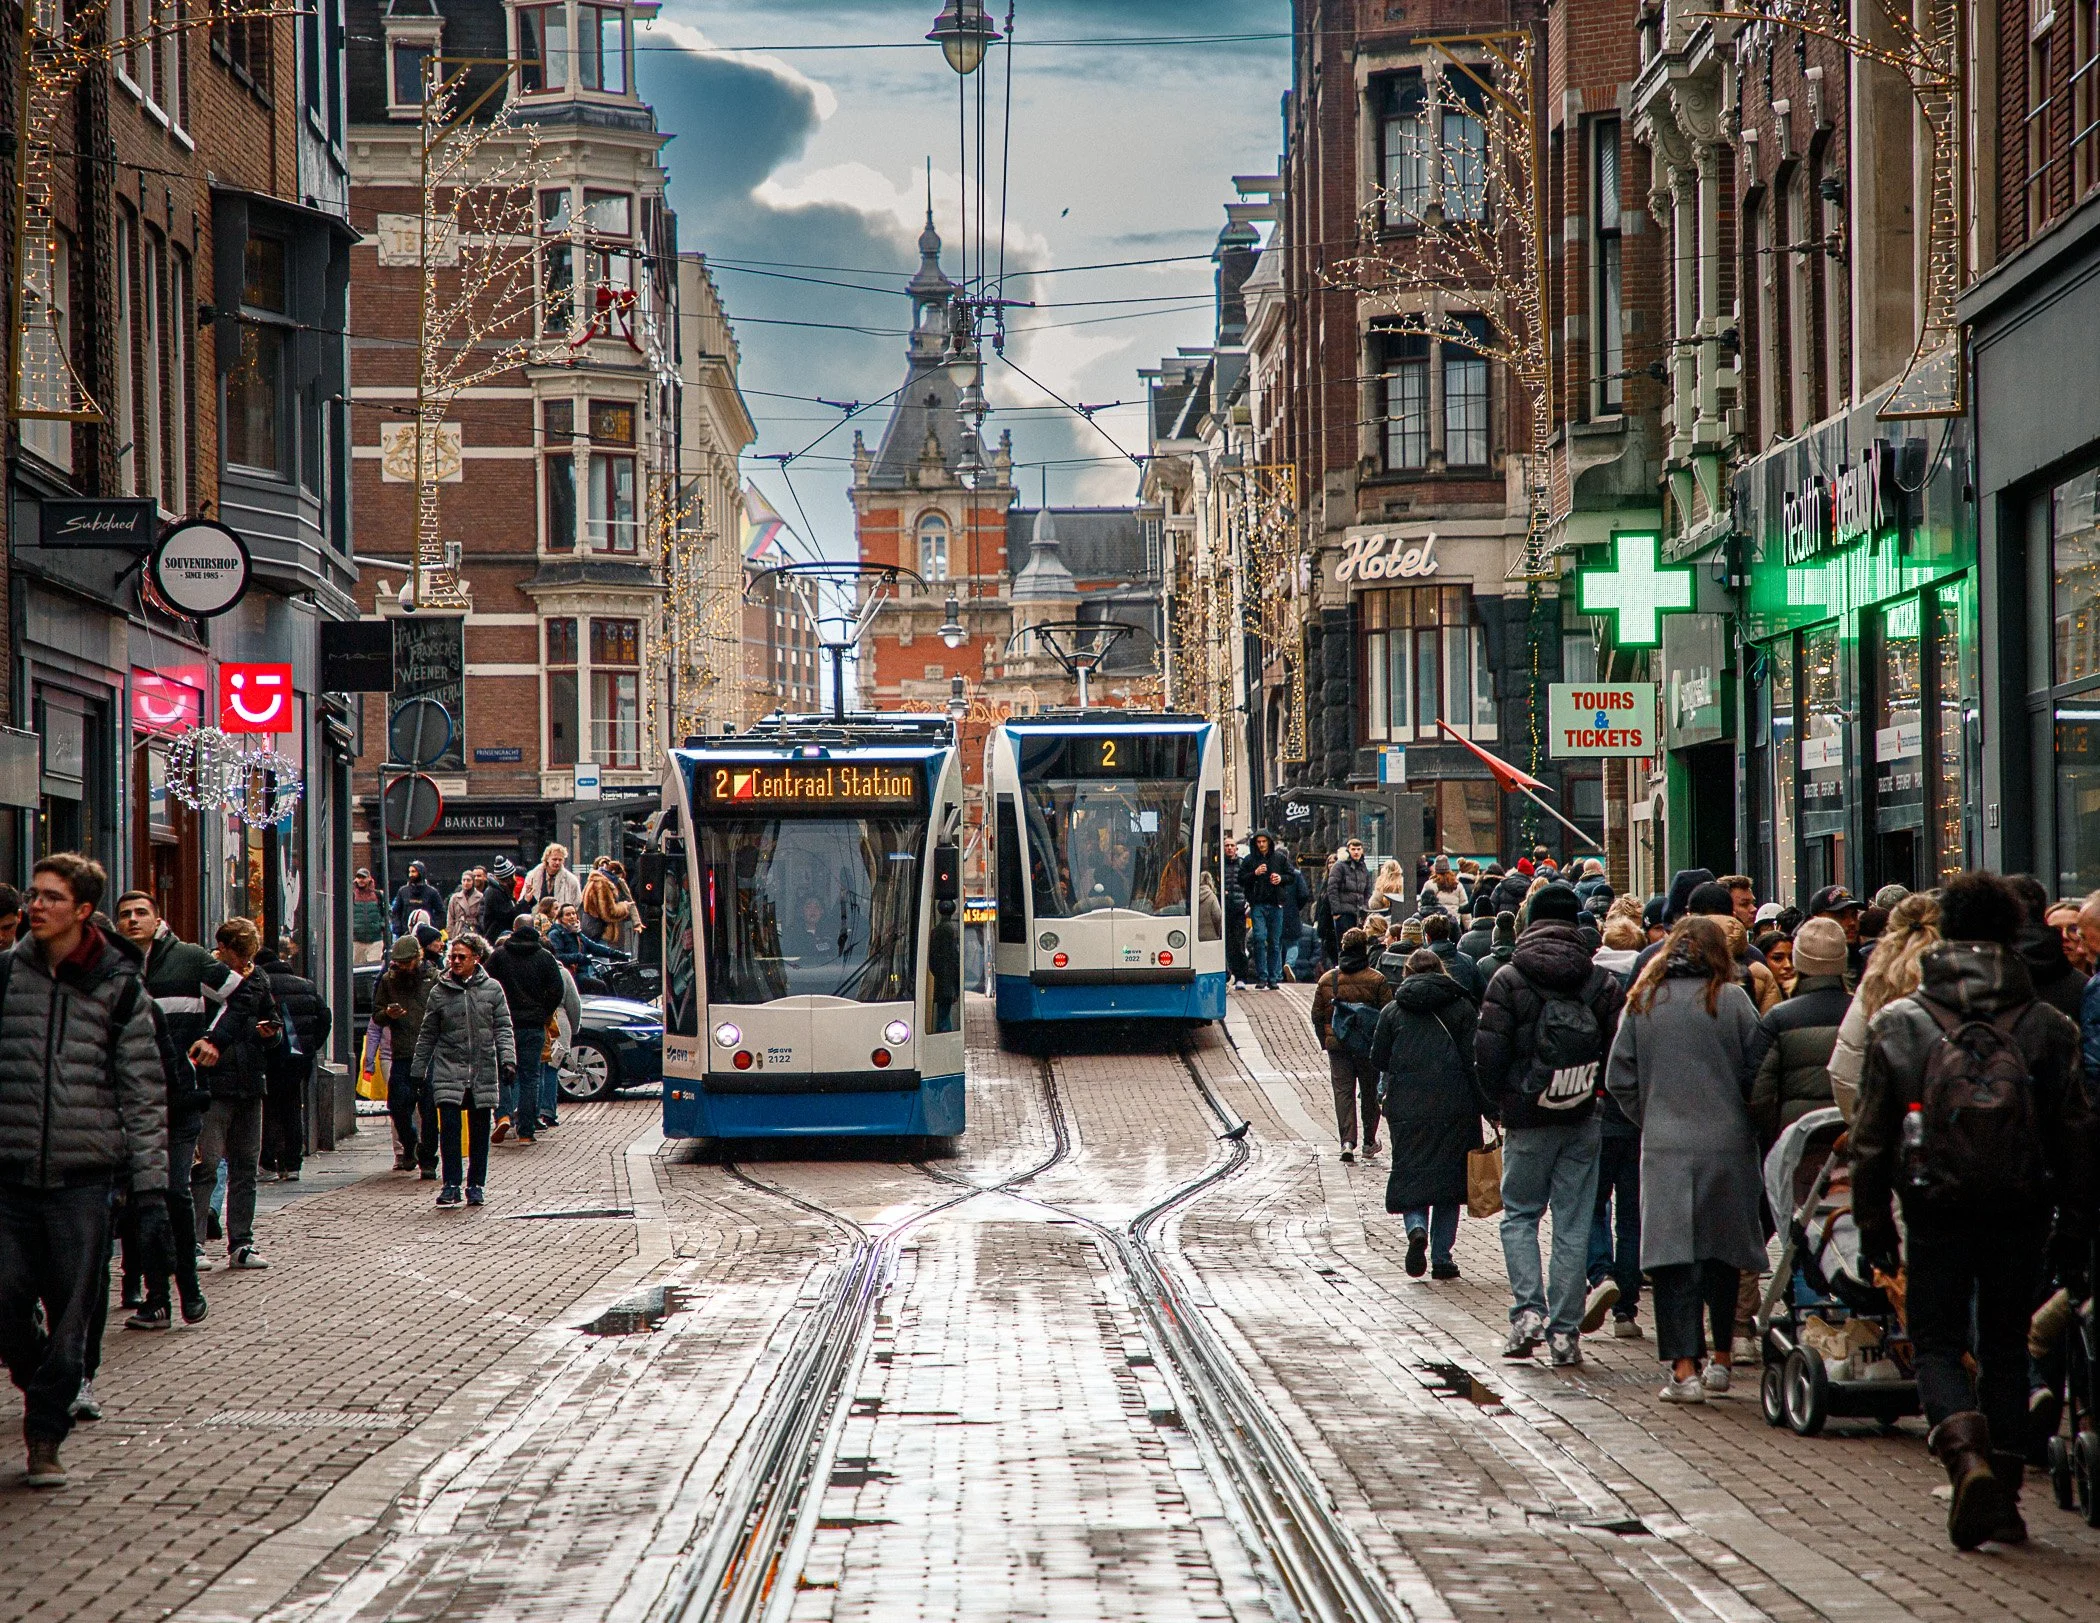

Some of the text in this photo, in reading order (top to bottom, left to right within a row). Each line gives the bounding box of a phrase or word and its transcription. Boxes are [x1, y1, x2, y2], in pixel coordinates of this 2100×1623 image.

[56, 512, 139, 534] Subdued
[165, 557, 238, 570] SOUVENIRSHOP
[1334, 531, 1439, 582] Hotel
[185, 571, 219, 579] SINCE 1985
[395, 664, 449, 683] WEENER
[1572, 692, 1634, 710] TOURS
[1594, 711, 1609, 729] &
[1564, 729, 1642, 748] TICKETS
[1102, 740, 1116, 767] 2
[715, 768, 912, 798] 2 Centraal Station
[1286, 801, 1310, 816] Etos
[444, 816, 505, 828] BAKKERIJ
[768, 1055, 791, 1063] 2122
